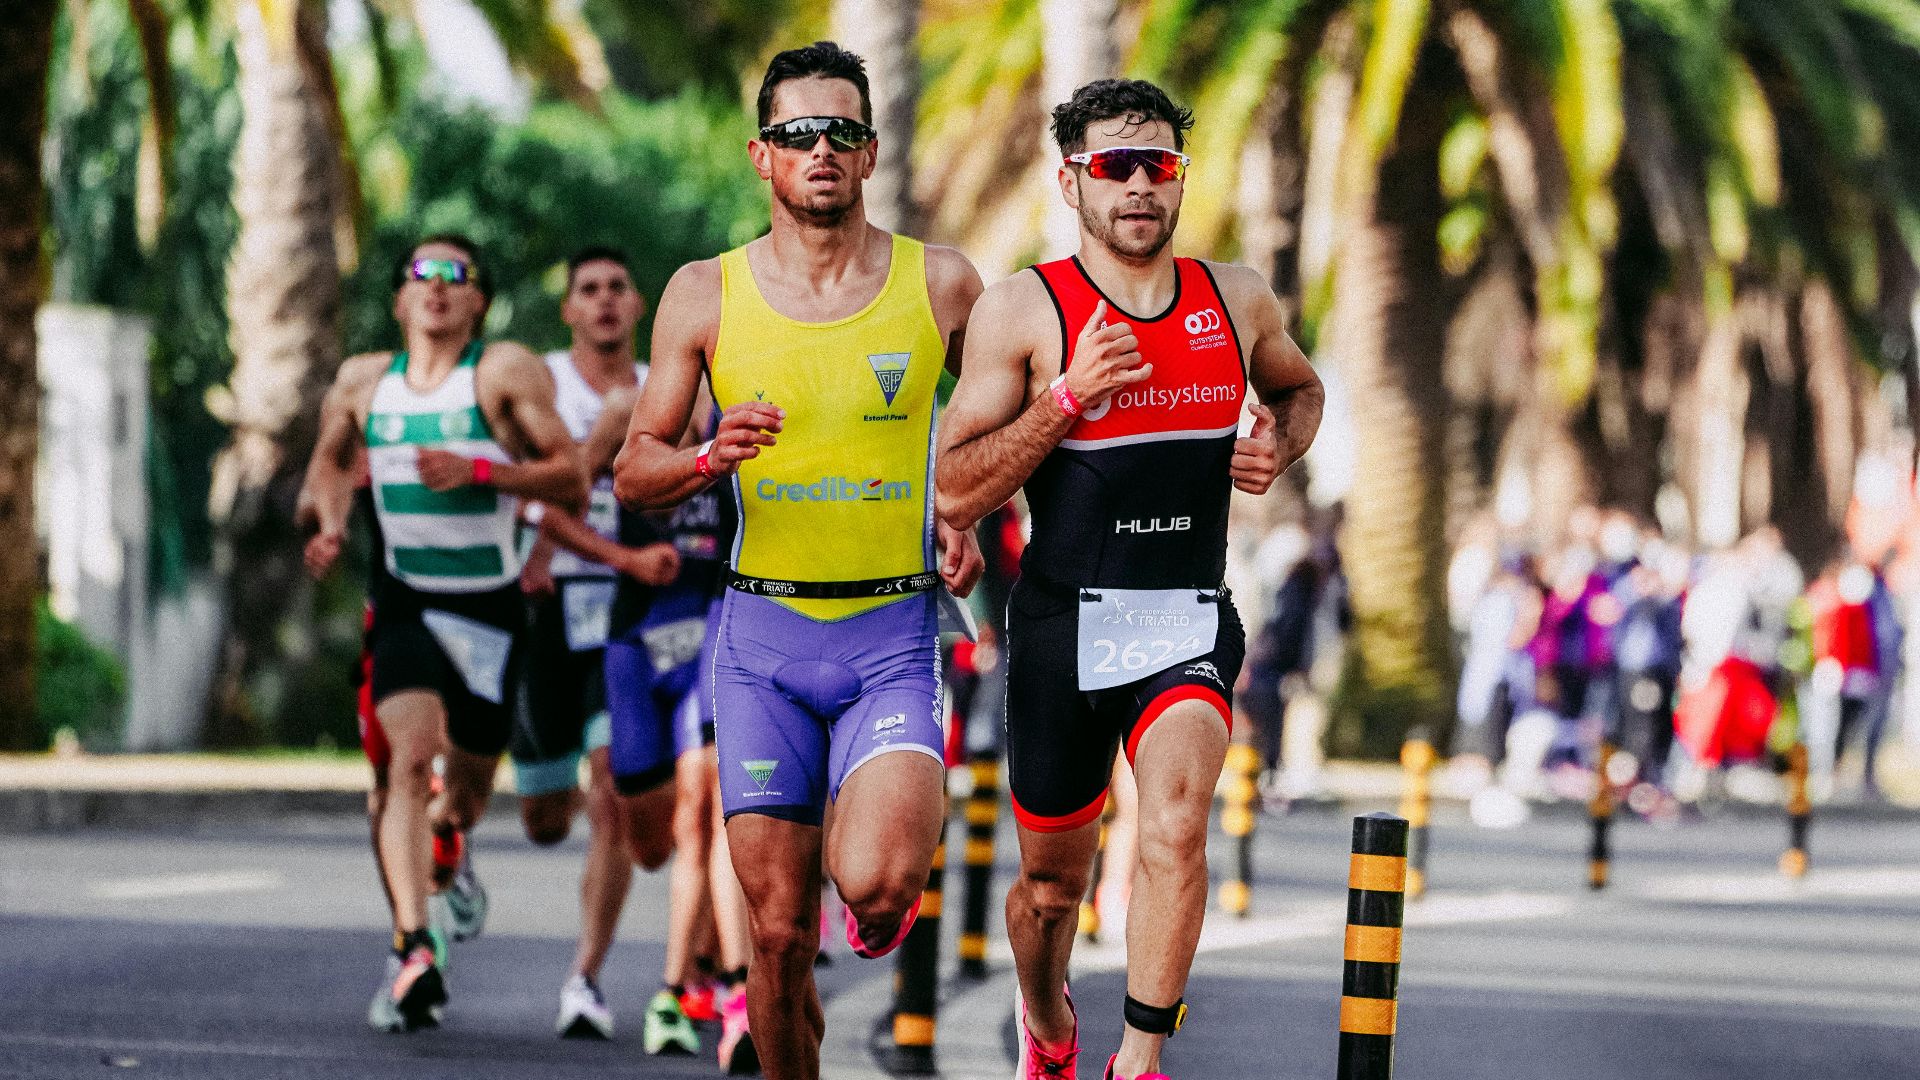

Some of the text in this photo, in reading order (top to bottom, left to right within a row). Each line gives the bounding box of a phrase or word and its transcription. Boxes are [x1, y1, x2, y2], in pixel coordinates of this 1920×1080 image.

[1189, 333, 1226, 346] OUTSYSTEMS
[1118, 382, 1237, 410] outsystems
[863, 413, 908, 422] Estoril Praia
[756, 476, 912, 502] Credibom
[1115, 516, 1191, 534] HUUB
[761, 583, 796, 594] TRIATLO
[909, 576, 937, 588] TRIATLO
[1137, 615, 1190, 627] TRIATLO
[1093, 635, 1201, 673] 2624
